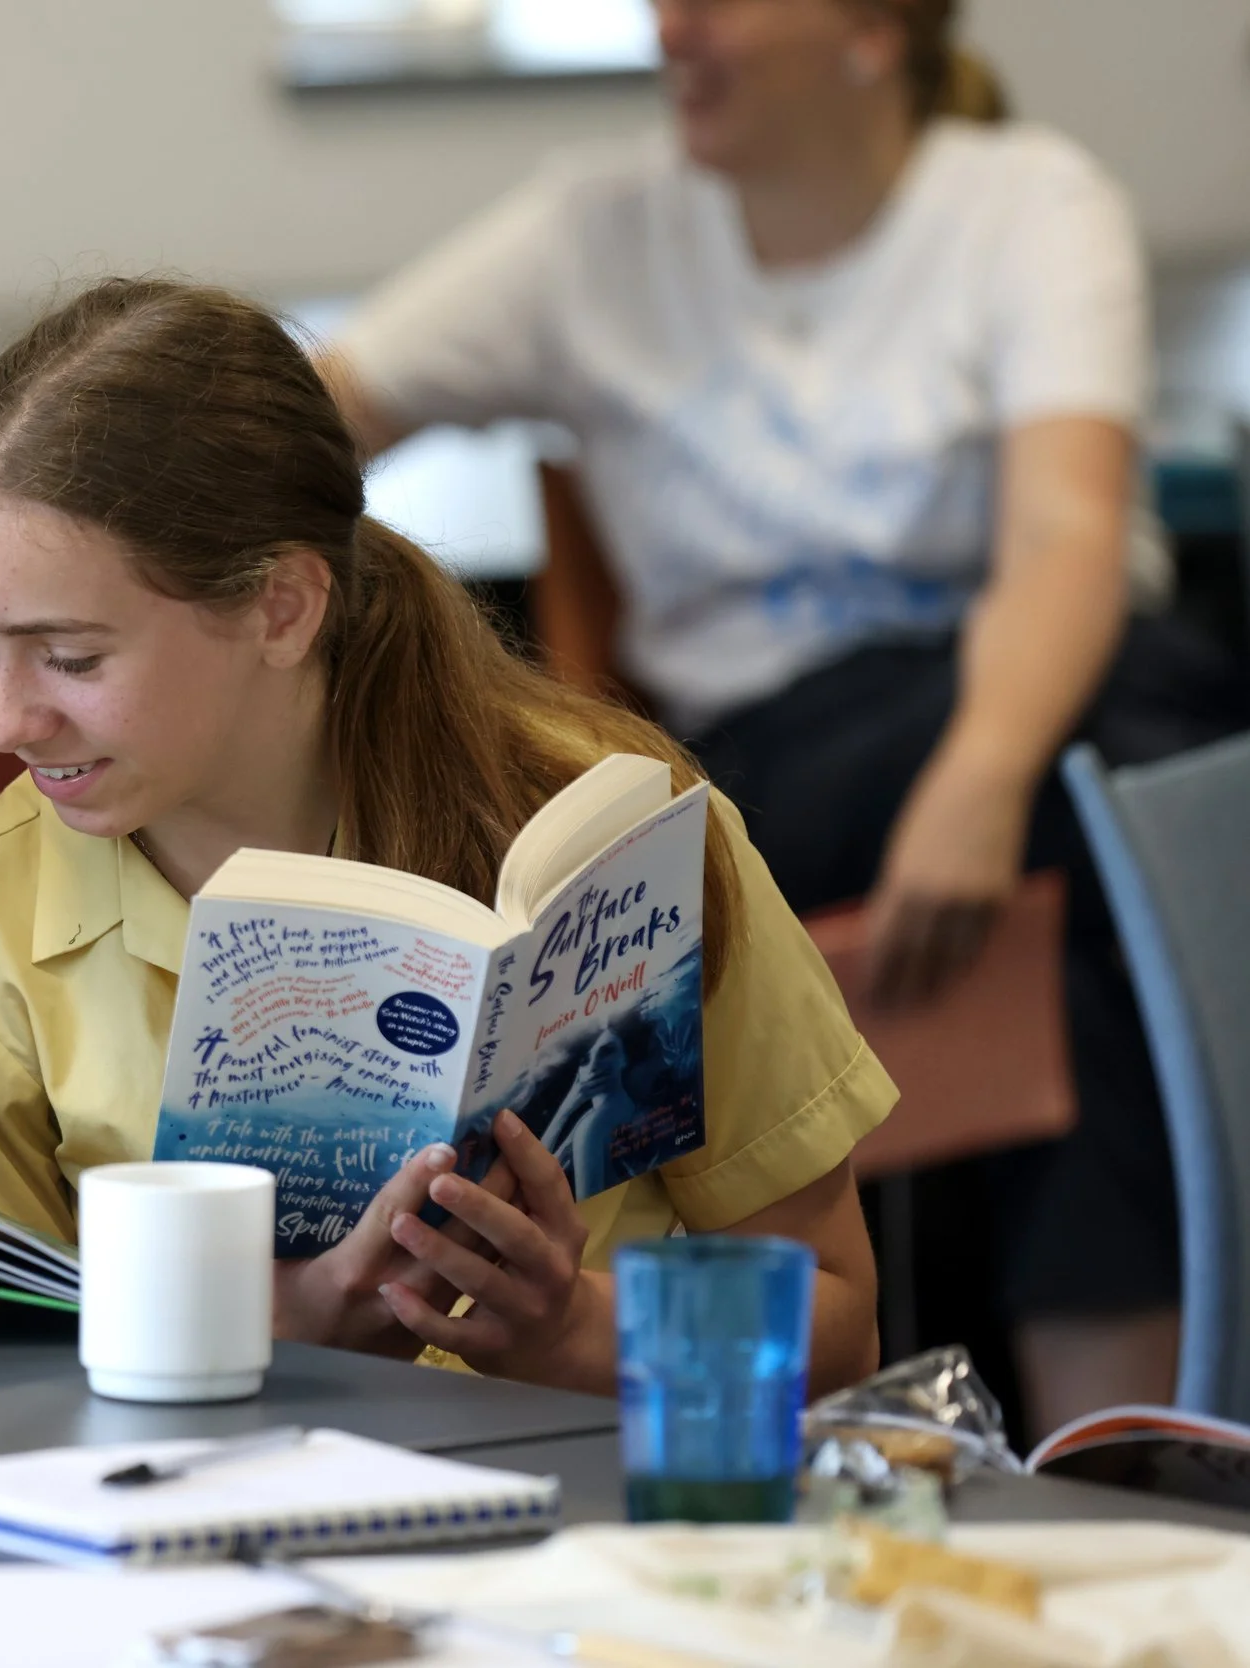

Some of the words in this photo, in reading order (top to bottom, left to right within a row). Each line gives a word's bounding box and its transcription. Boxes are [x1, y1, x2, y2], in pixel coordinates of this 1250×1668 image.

[528, 880, 647, 1008] Surface
[574, 905, 681, 996] Breaks
[584, 960, 647, 1017] O'Neill
[394, 998, 431, 1015] Discover
[217, 1034, 291, 1071] powerful
[292, 1024, 363, 1054] feminist
[360, 1048, 401, 1071] story
[409, 1058, 444, 1078] with
[397, 1034, 433, 1050] chapter
[228, 1066, 267, 1082] most
[272, 1048, 354, 1077] energising
[325, 1075, 384, 1101] Marian
[391, 1091, 437, 1112] Keyes
[259, 1124, 294, 1144] with
[333, 1126, 390, 1143] darkest
[397, 1128, 417, 1147] of
[333, 1142, 378, 1177] full
[275, 1167, 326, 1191] llying
[275, 1211, 354, 1244] Spellbi
